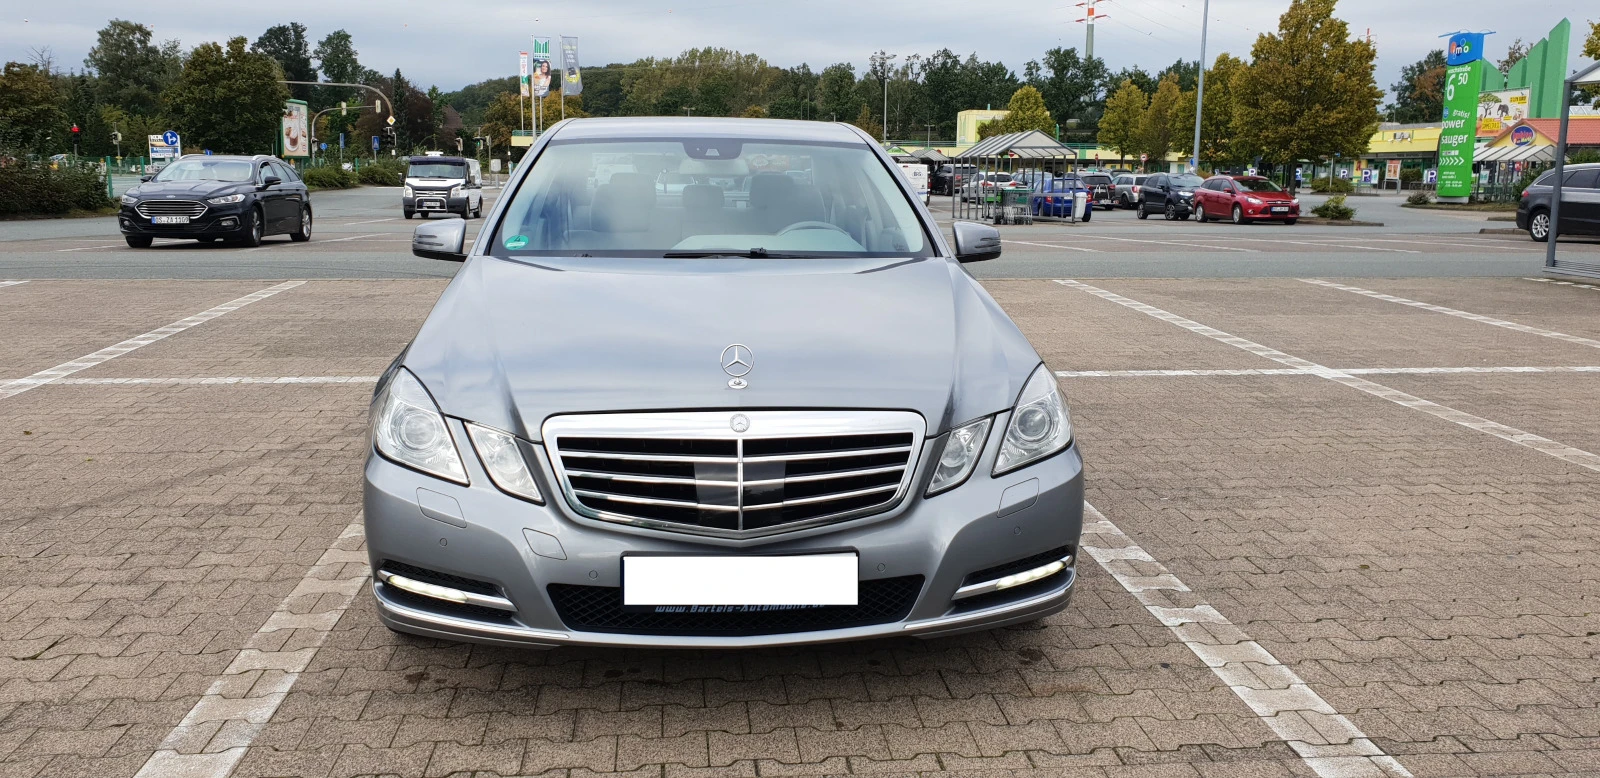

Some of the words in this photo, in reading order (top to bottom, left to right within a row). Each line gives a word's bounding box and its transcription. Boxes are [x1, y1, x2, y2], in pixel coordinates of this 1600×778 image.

[1458, 72, 1468, 86] 50
[1441, 134, 1468, 147] sauger
[1340, 169, 1348, 179] P
[1362, 169, 1371, 182] P
[1428, 170, 1436, 183] P
